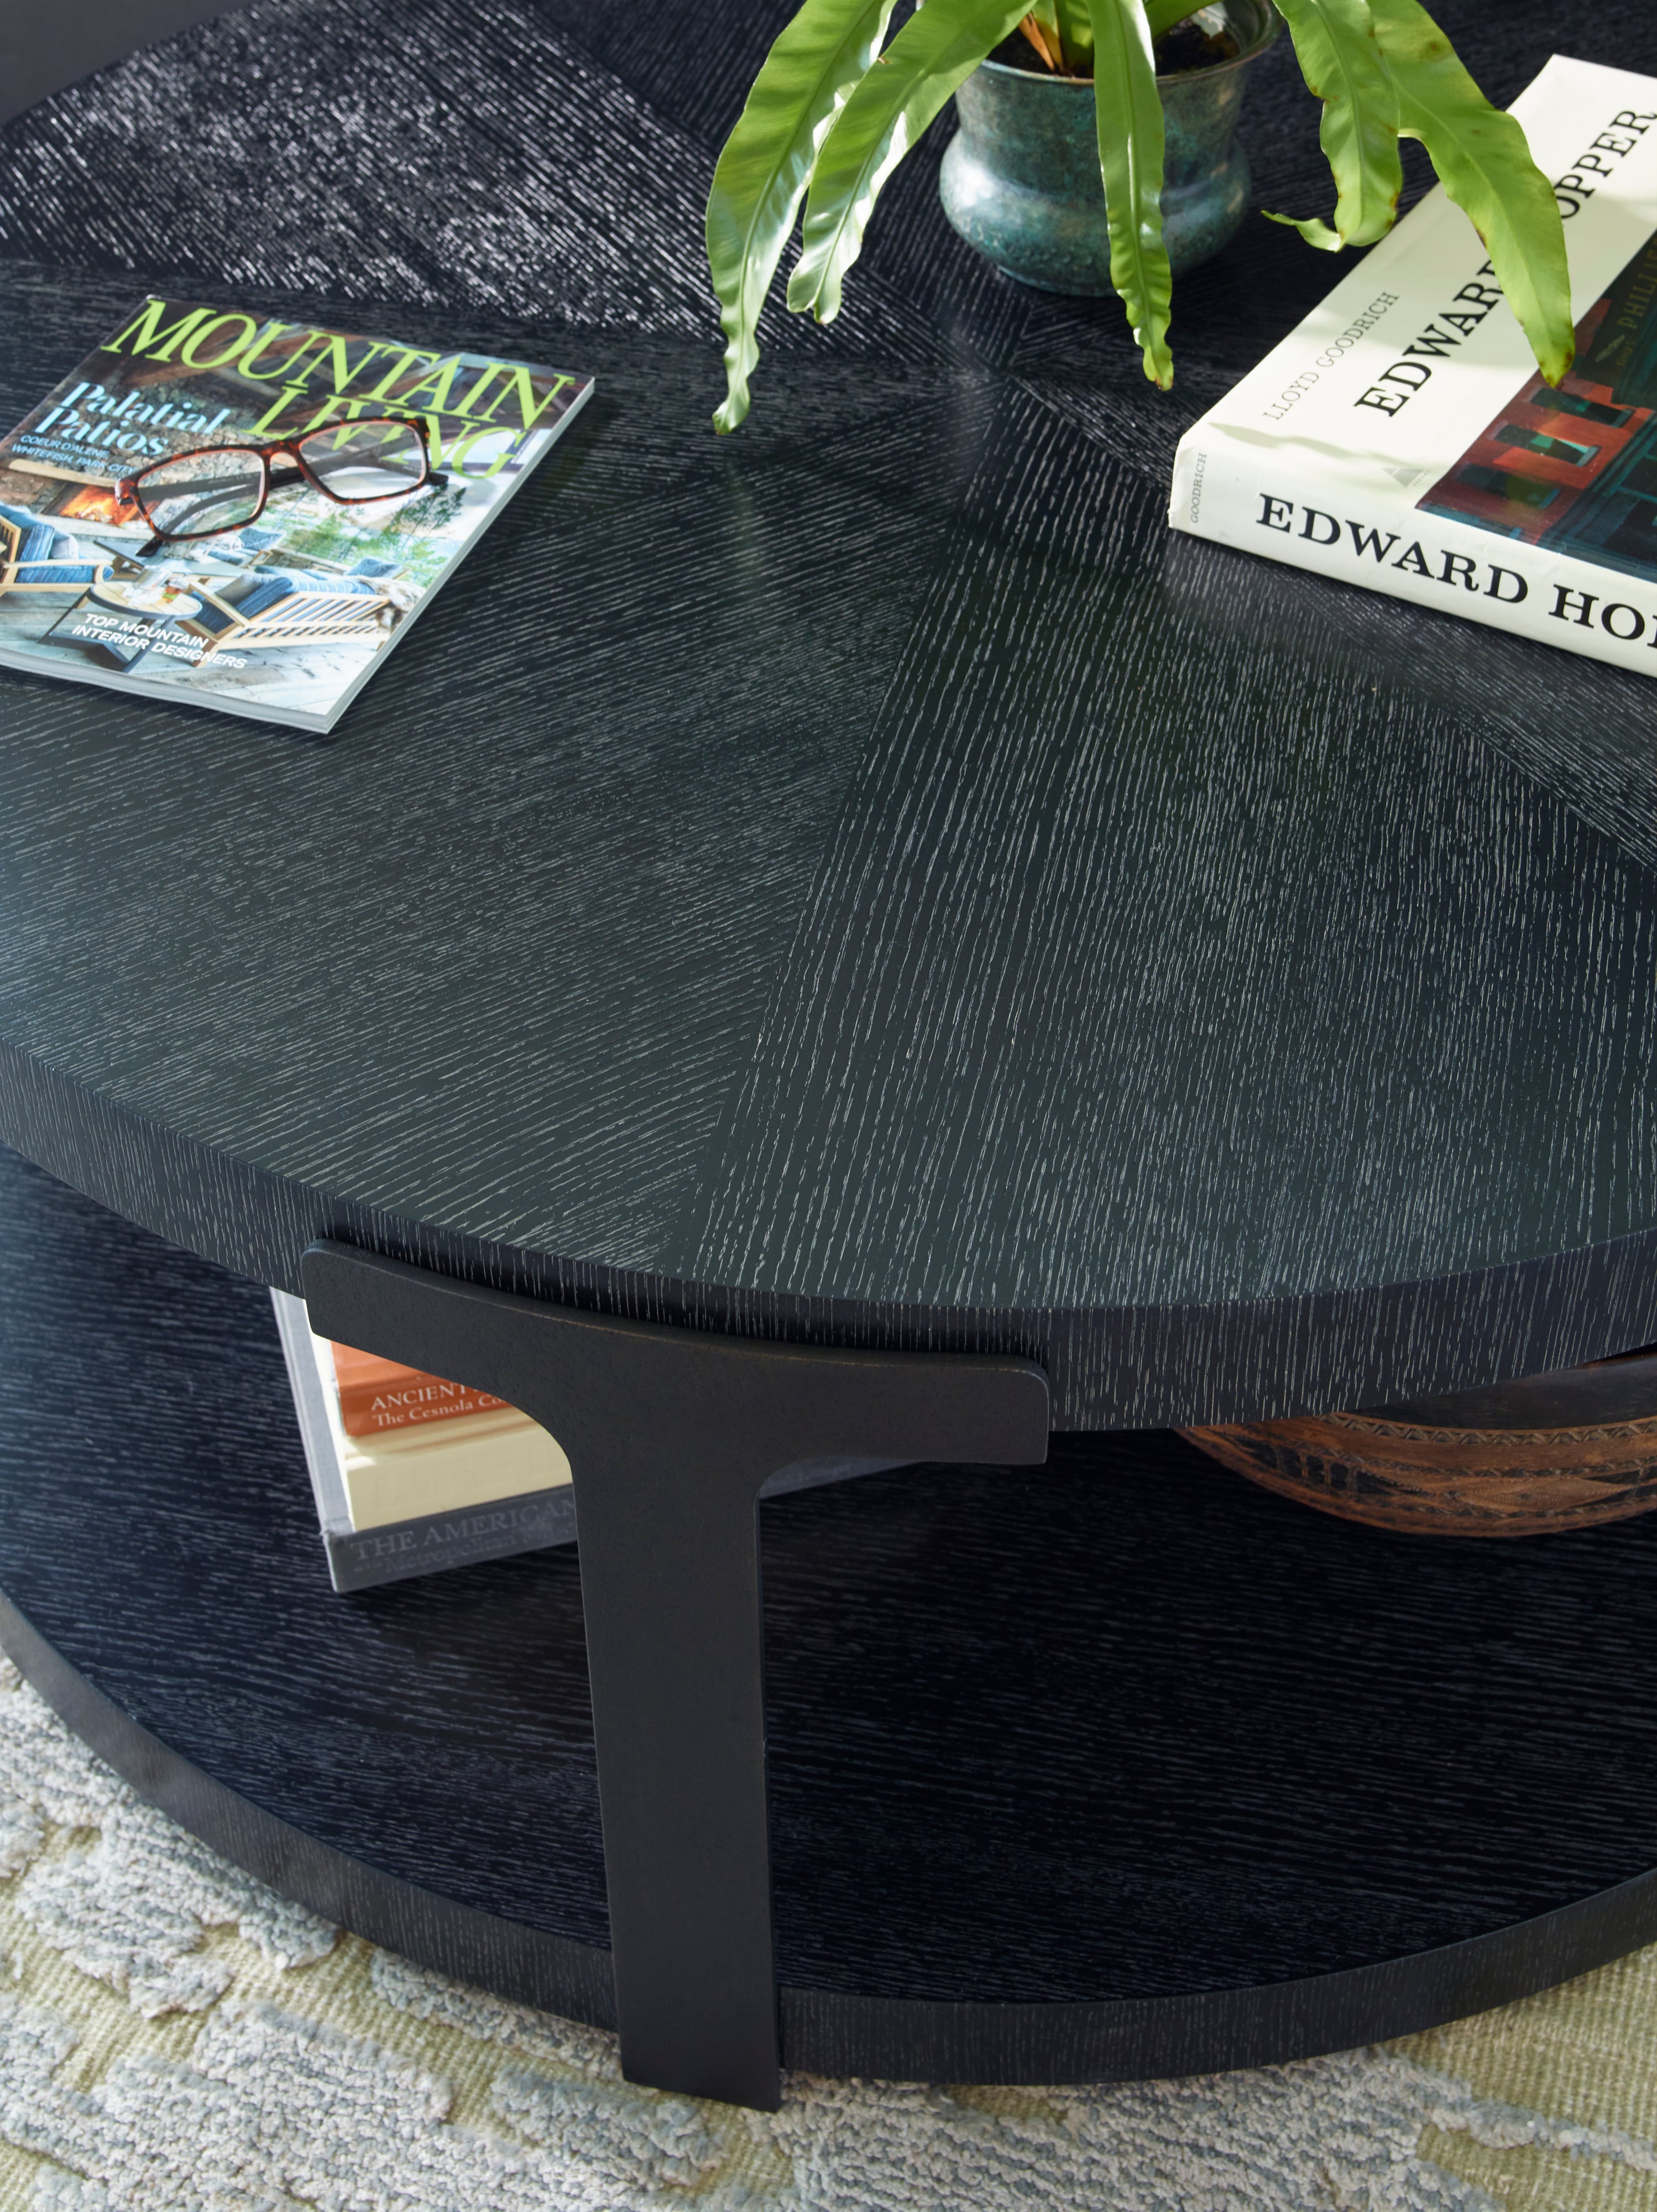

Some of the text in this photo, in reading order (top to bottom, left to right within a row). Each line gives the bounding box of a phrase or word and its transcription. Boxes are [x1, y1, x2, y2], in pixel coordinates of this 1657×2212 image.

[1553, 109, 1657, 220] OPPER
[100, 299, 576, 430] MOUNTAIN
[1262, 291, 1400, 420] LLOYD GOODRICH
[34, 406, 169, 455] Patios
[60, 382, 231, 434] Palatial
[20, 435, 62, 448] COEUR
[76, 456, 106, 470] PARK
[108, 463, 140, 474] CITY
[1190, 452, 1207, 523] GOODRICH
[1256, 493, 1529, 603] EDWARD
[72, 625, 248, 669] INTERIOR DESIGNERS
[85, 613, 210, 648] TOP MOUNTAIN
[371, 1383, 467, 1411] ANCIENT
[373, 1394, 505, 1426] The Cesnola Co
[350, 1530, 417, 1560] THE
